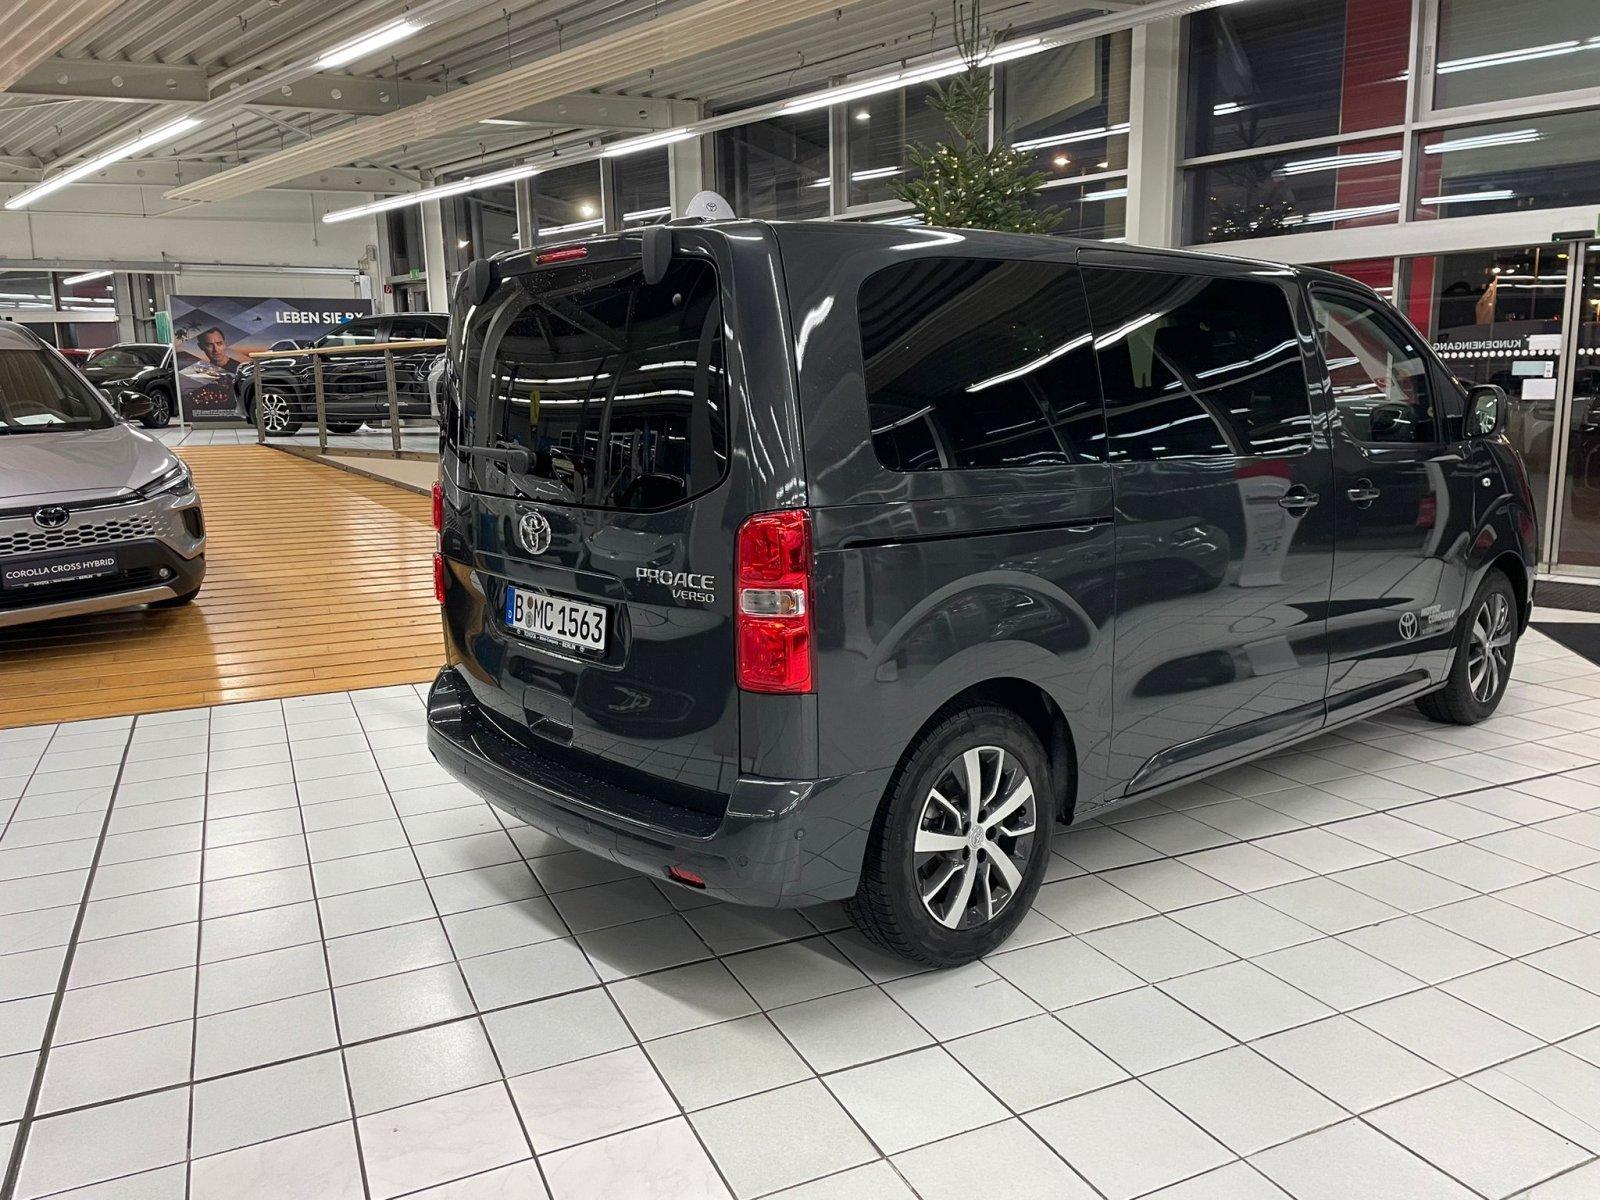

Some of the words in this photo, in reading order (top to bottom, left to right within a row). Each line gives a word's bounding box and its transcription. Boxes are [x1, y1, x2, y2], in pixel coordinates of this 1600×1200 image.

[275, 311, 320, 324] LEBEN
[322, 311, 342, 324] SIE
[5, 566, 50, 579] COROLLA
[51, 562, 81, 573] CROSS
[82, 558, 114, 569] HYBRID
[636, 566, 715, 590] PROACE
[672, 589, 715, 603] VERSO
[515, 594, 524, 622] B
[533, 598, 554, 631] MC
[557, 605, 603, 643] 1563
